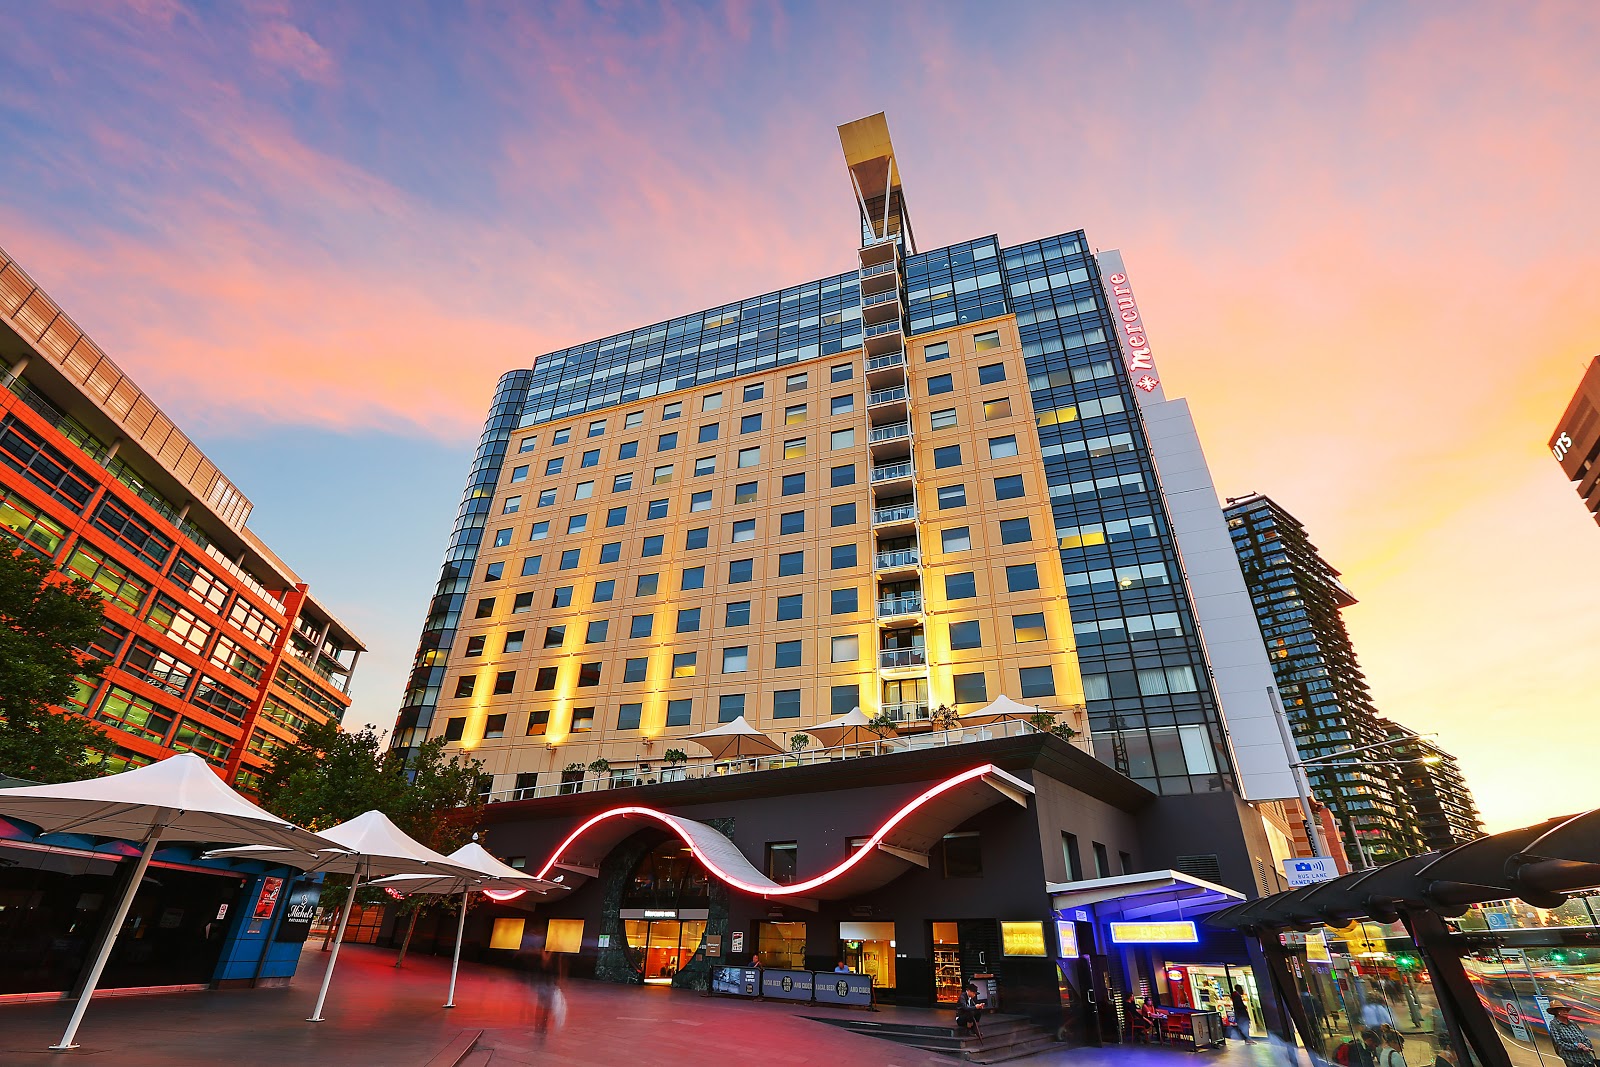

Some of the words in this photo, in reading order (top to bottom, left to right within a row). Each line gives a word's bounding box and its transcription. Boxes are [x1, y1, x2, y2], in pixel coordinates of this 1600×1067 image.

[1110, 273, 1153, 372] mercure
[1552, 432, 1573, 462] UTS
[287, 904, 314, 919] Michel's
[1013, 933, 1034, 944] EVE'S
